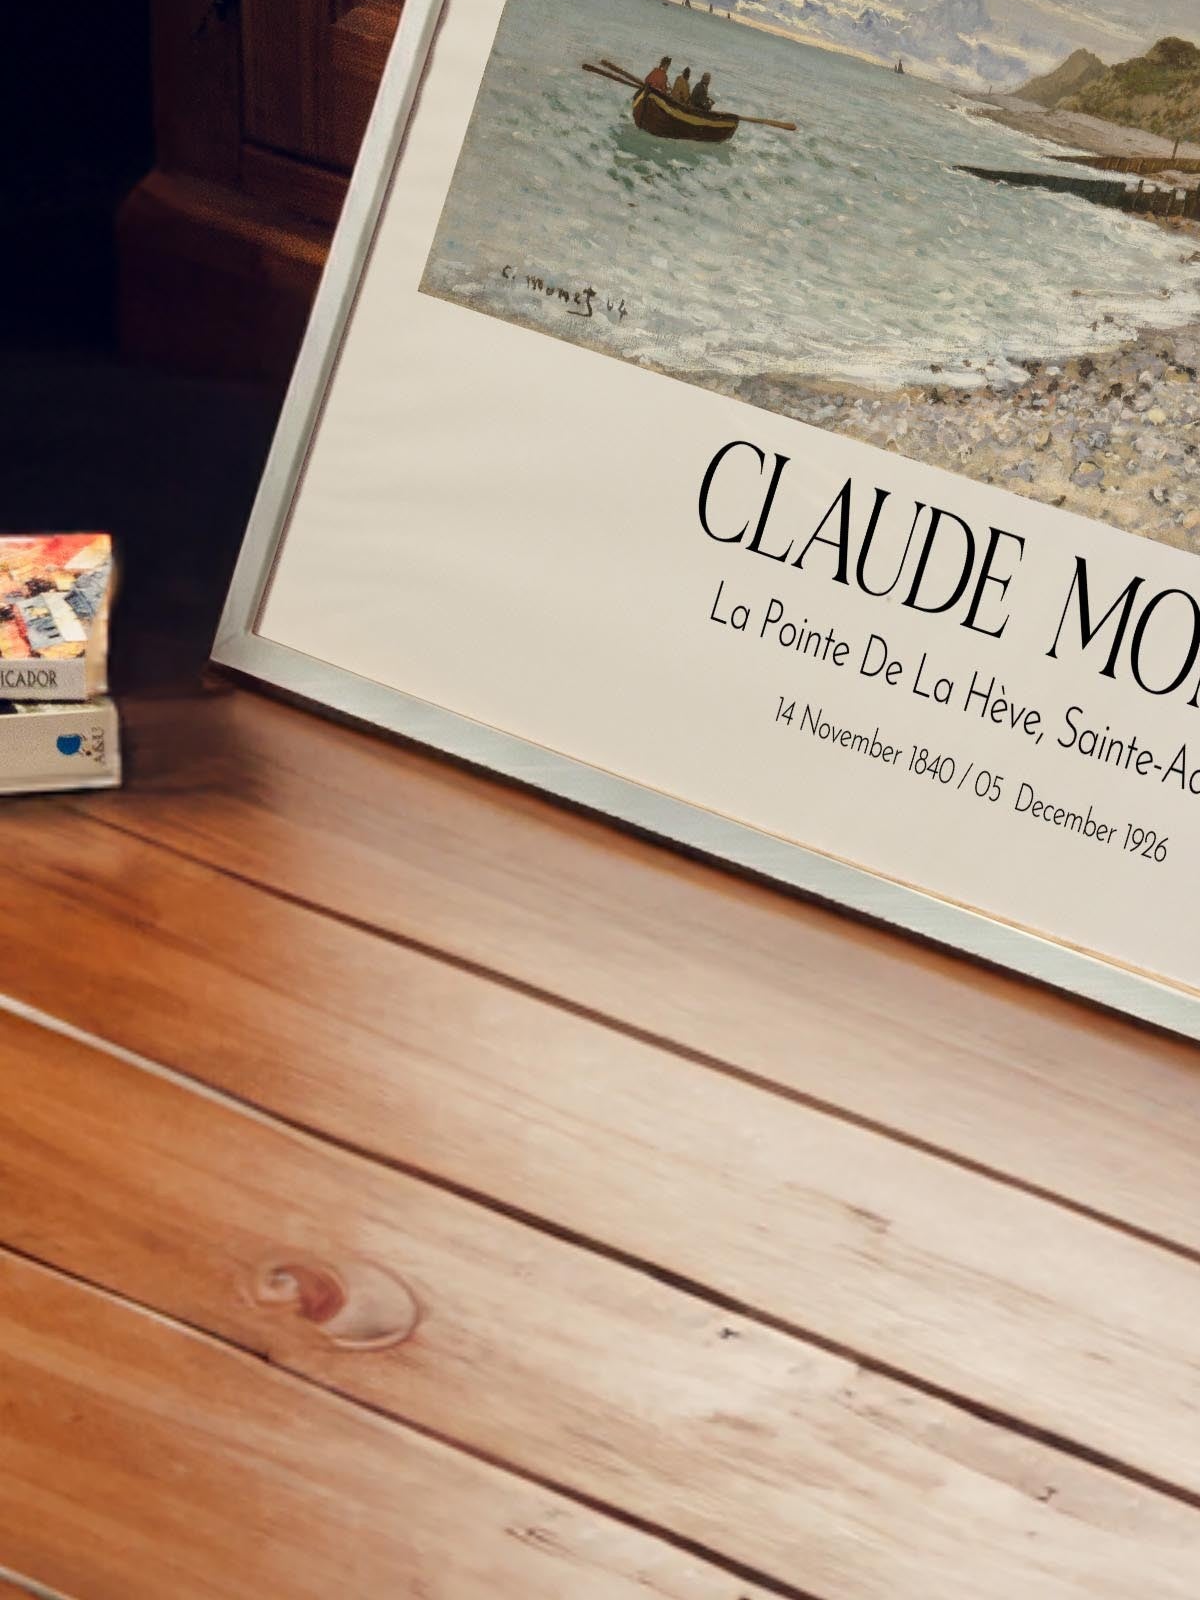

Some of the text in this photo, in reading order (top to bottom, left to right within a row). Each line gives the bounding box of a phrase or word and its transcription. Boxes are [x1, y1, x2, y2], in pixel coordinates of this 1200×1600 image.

[698, 440, 1026, 639] CLAUDE
[0, 669, 58, 688] ICADOR
[709, 579, 751, 632] La
[759, 597, 850, 667] Pointe
[859, 633, 903, 686] De
[912, 652, 955, 705] La
[963, 670, 1044, 745] Hève,
[775, 696, 1169, 863] 14 November 1840 / 05 December 1926
